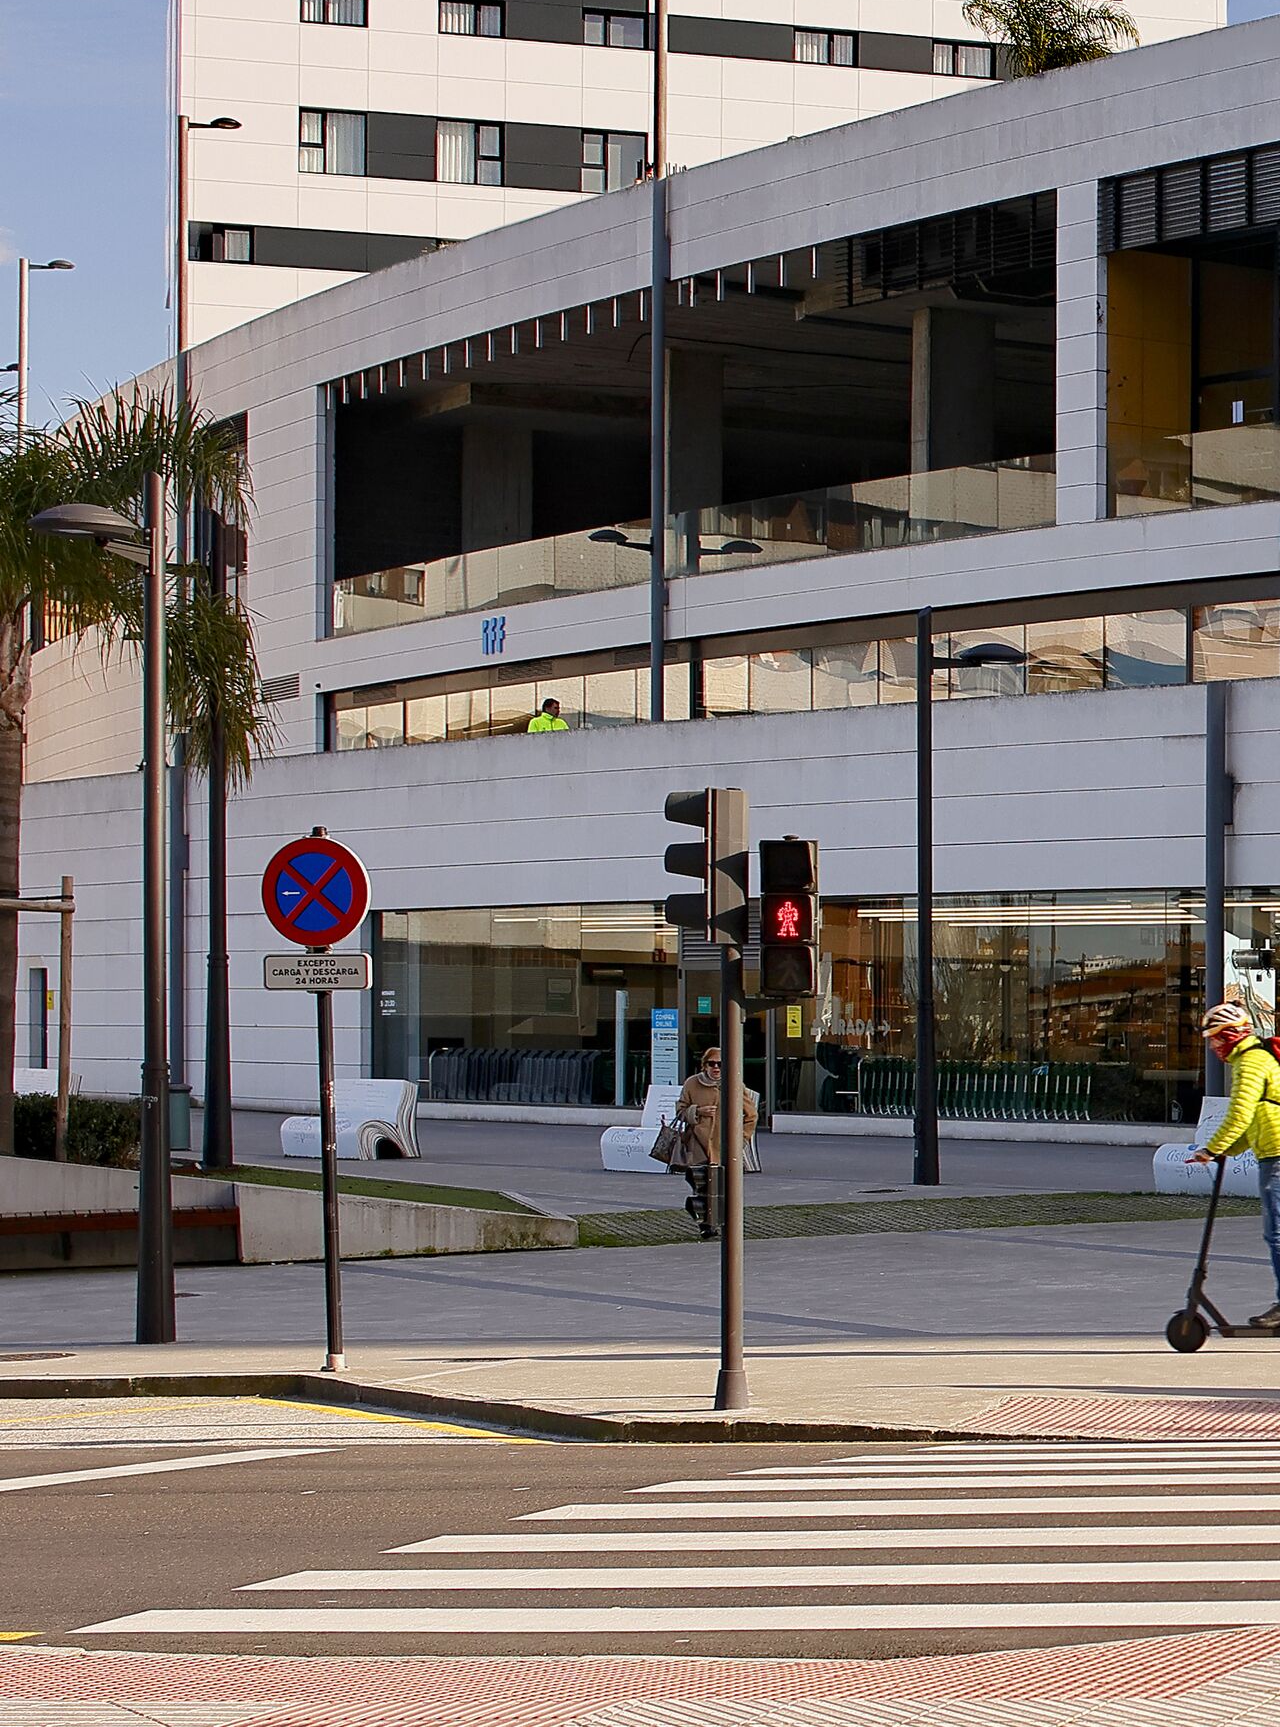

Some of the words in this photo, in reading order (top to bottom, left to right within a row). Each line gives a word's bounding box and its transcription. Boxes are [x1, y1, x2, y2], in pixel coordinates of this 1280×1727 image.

[297, 959, 336, 967] EXCEPTO
[272, 968, 302, 976] CARGA
[304, 968, 311, 976] Y
[312, 968, 360, 976] DESCARGA
[295, 977, 307, 985] 24
[309, 977, 340, 985] HORAS
